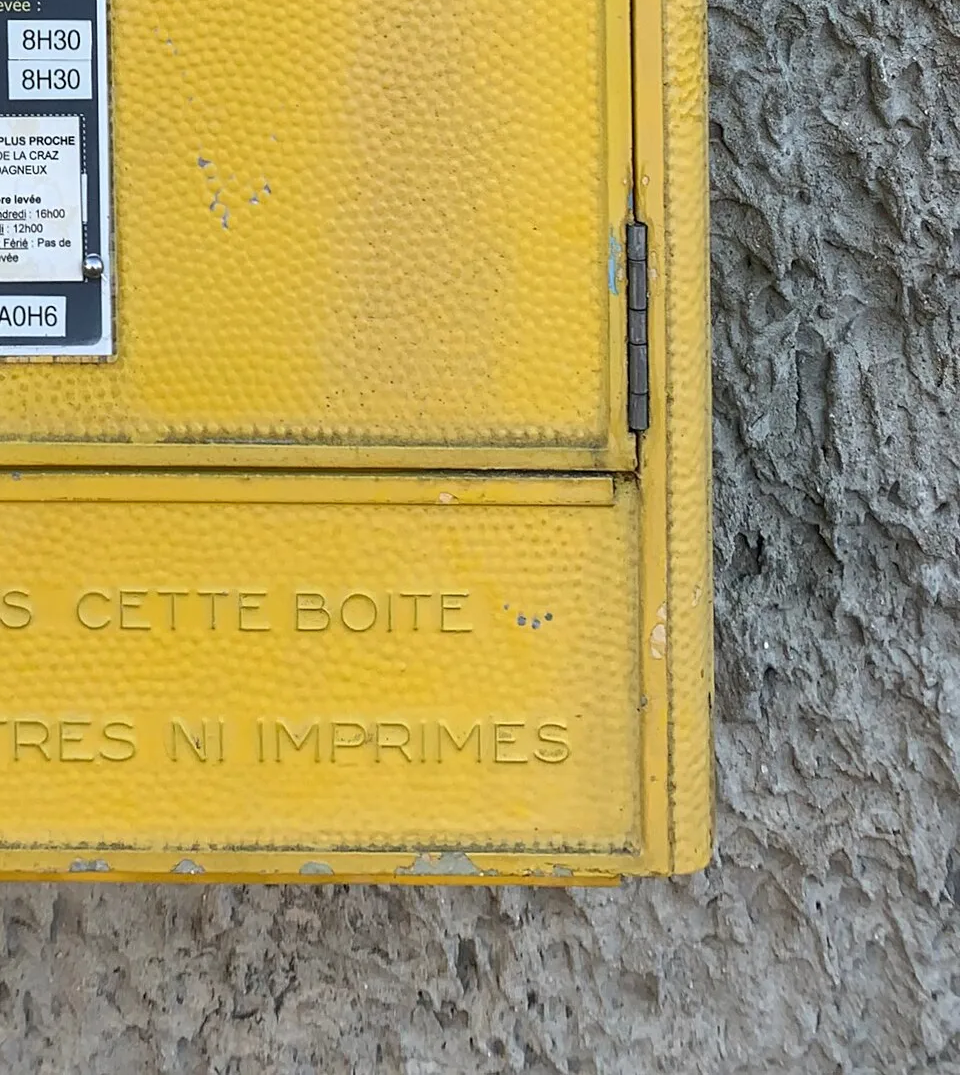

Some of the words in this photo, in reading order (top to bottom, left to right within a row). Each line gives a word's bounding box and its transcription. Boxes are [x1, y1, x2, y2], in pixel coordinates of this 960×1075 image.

[22, 29, 81, 50] 8H30
[22, 69, 81, 90] 8H30
[29, 136, 75, 146] PROCHE
[13, 151, 27, 161] LA
[29, 150, 59, 161] CRAZ
[14, 195, 41, 204] levée
[35, 209, 65, 219] 16h00
[13, 224, 43, 233] 12h00
[4, 238, 28, 249] Férié
[38, 238, 56, 248] Pas
[59, 238, 71, 248] de
[75, 590, 271, 632] CETTE
[294, 591, 473, 633] BOITE
[170, 720, 226, 764] NI
[257, 720, 570, 764] IMPRIMES
